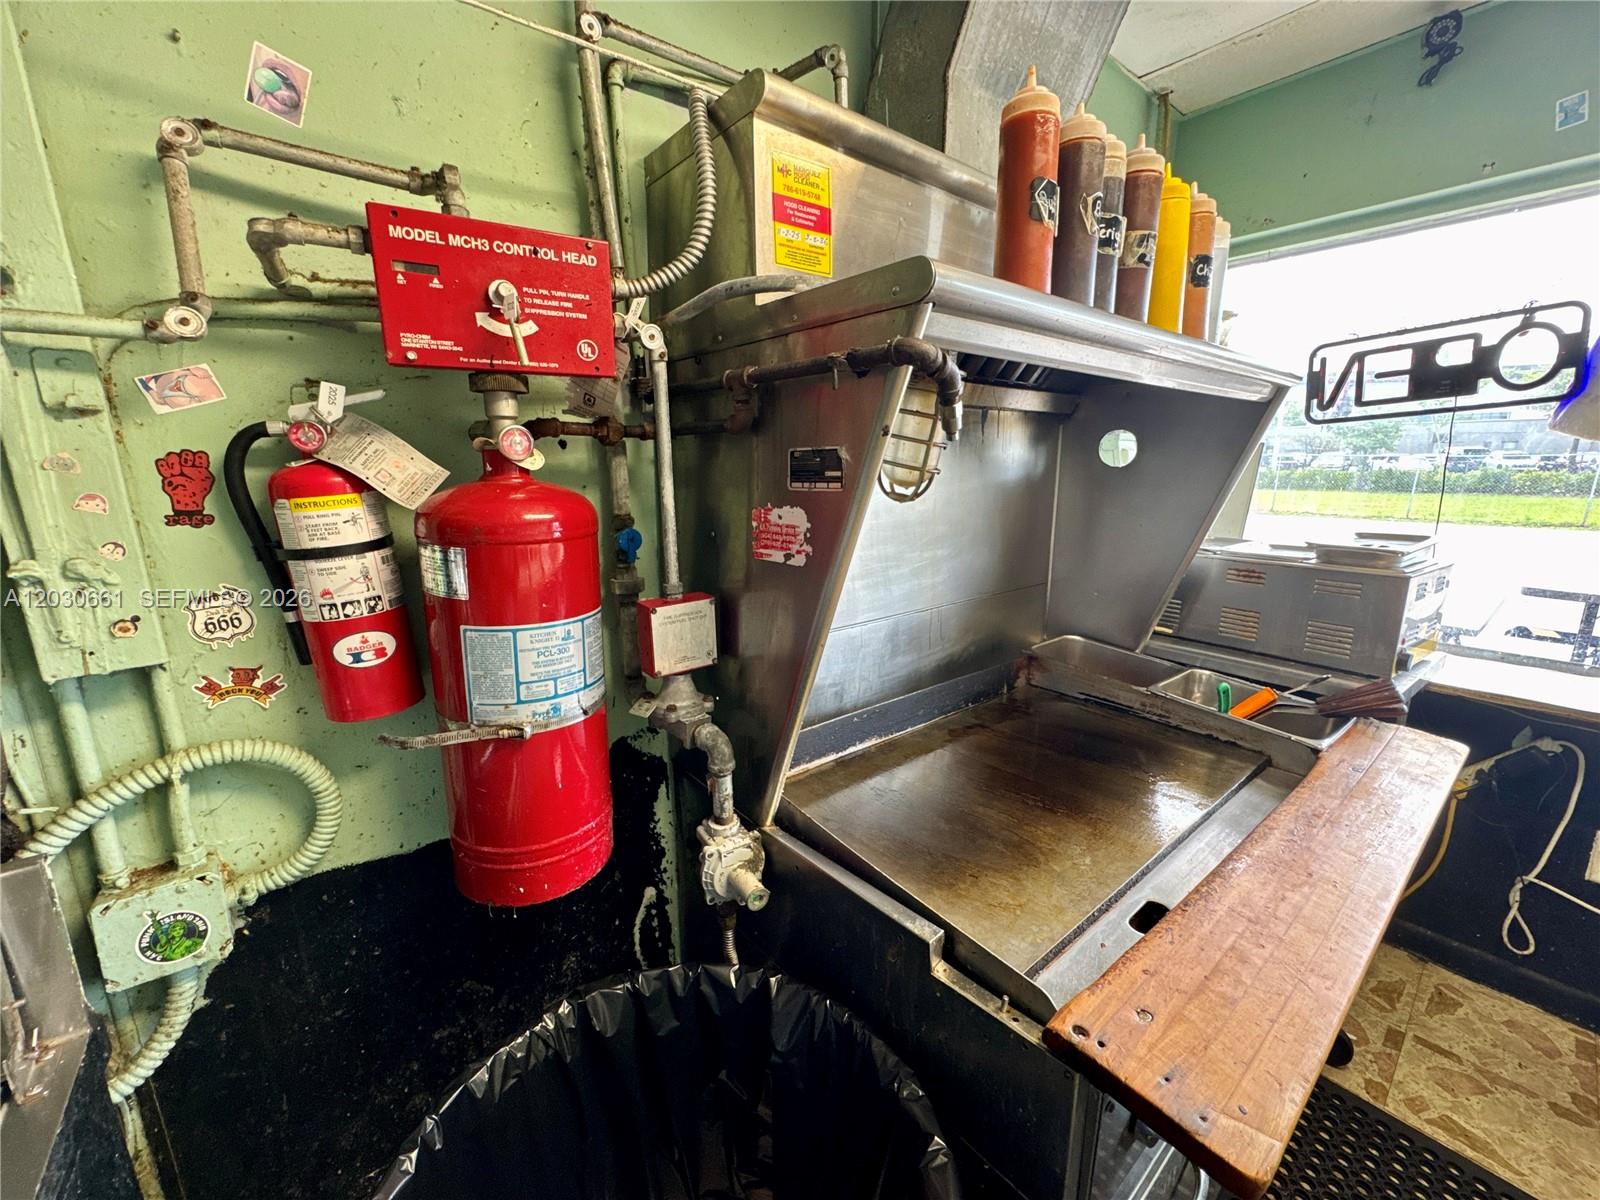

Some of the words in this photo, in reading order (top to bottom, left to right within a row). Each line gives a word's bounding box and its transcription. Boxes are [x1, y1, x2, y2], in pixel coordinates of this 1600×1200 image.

[388, 224, 445, 245] MODEL
[448, 233, 490, 251] MCH3
[493, 240, 559, 261] CONTROL
[562, 251, 597, 266] HEAD
[523, 287, 538, 295] PULL
[551, 290, 566, 298] TURN
[567, 292, 590, 300] HANDLE
[533, 298, 559, 307] RELEASE
[565, 310, 588, 320] SYSTEM
[293, 497, 358, 510] INSTRUCTIONS
[167, 515, 213, 527] rage
[204, 612, 242, 635] 666
[346, 641, 384, 652] BADGER
[537, 646, 570, 659] PCL-300
[218, 687, 244, 698] ROCK
[245, 688, 262, 697] YOU
